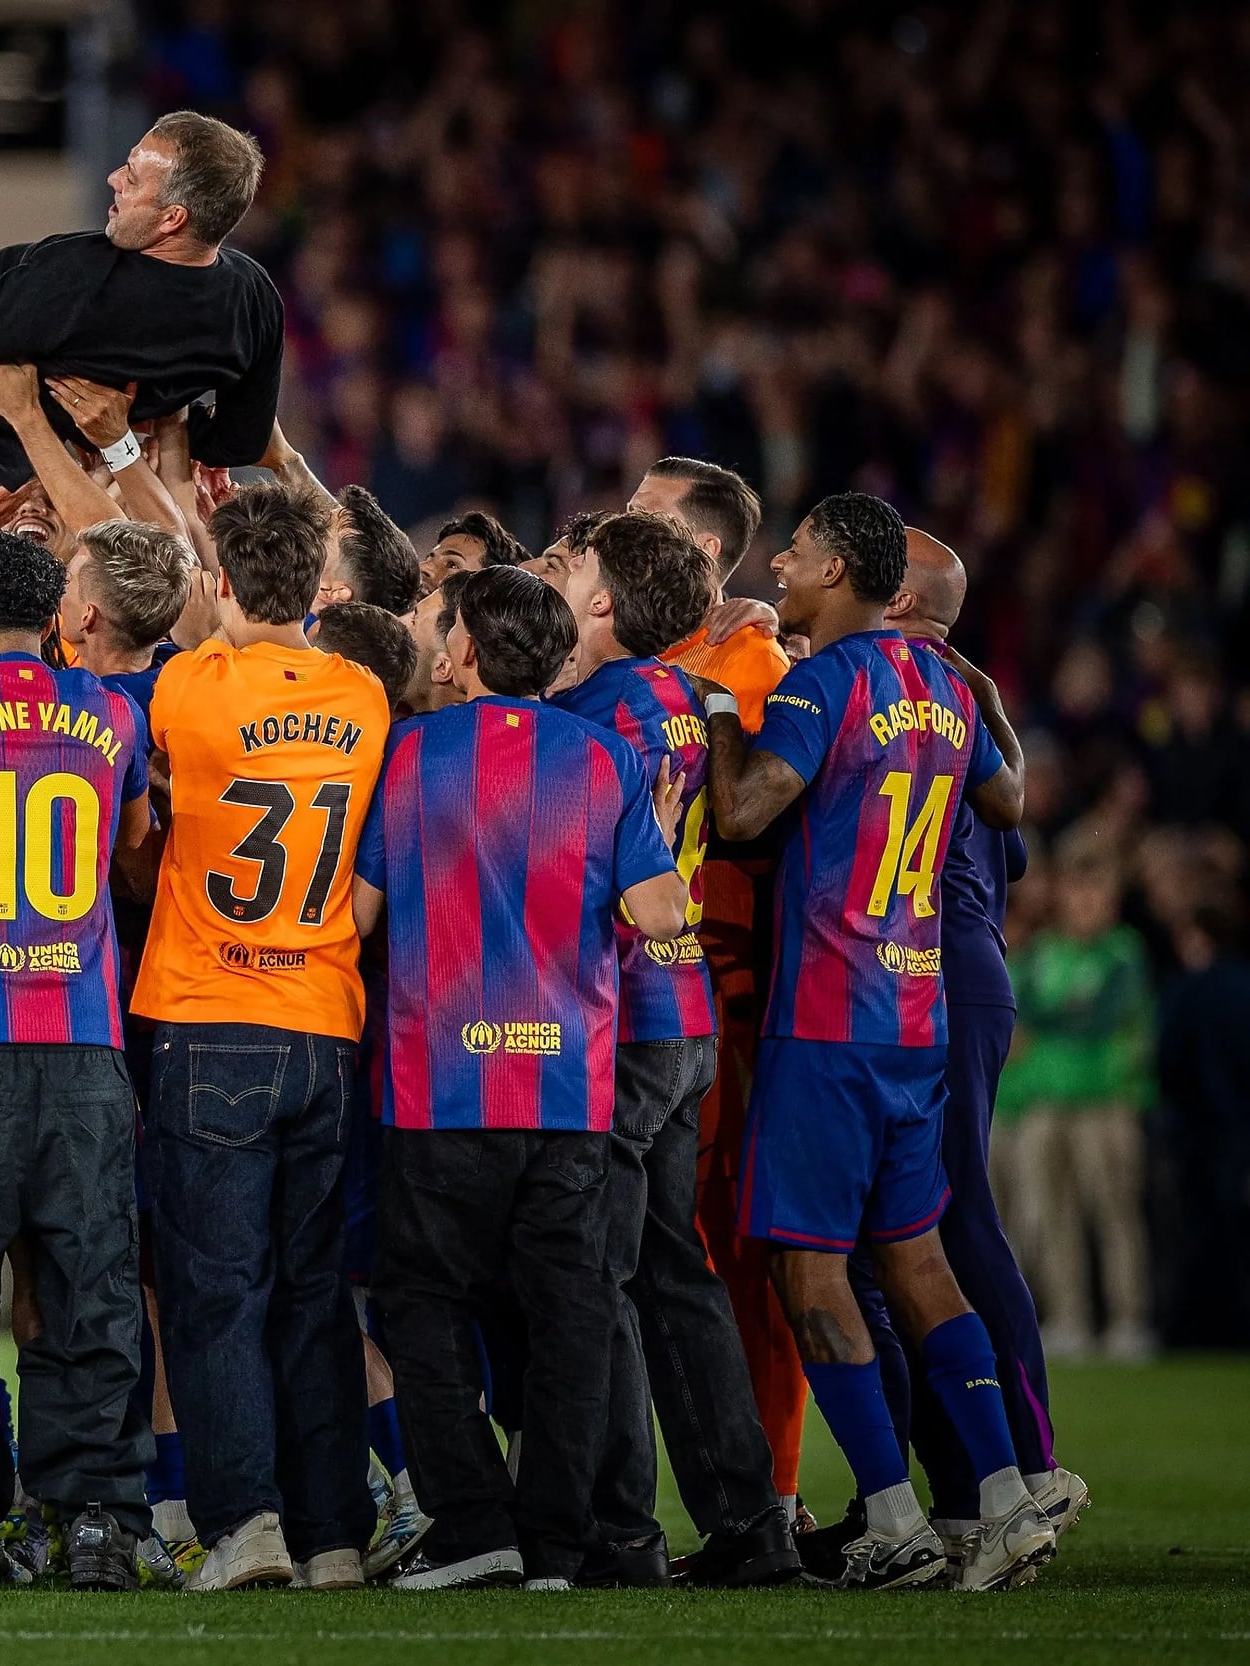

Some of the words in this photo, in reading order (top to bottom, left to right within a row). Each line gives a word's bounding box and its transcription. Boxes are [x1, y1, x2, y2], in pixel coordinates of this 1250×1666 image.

[38, 702, 124, 767] YAMAL
[238, 713, 363, 756] KOCHEN
[206, 778, 352, 926] 31
[866, 771, 954, 918] 14
[28, 941, 79, 957] UNHCR
[29, 954, 81, 969] ACNUR
[259, 953, 306, 968] ACNUR
[906, 959, 940, 972] ACNU
[504, 1022, 561, 1036] UNHCR
[504, 1035, 561, 1049] ACNUR
